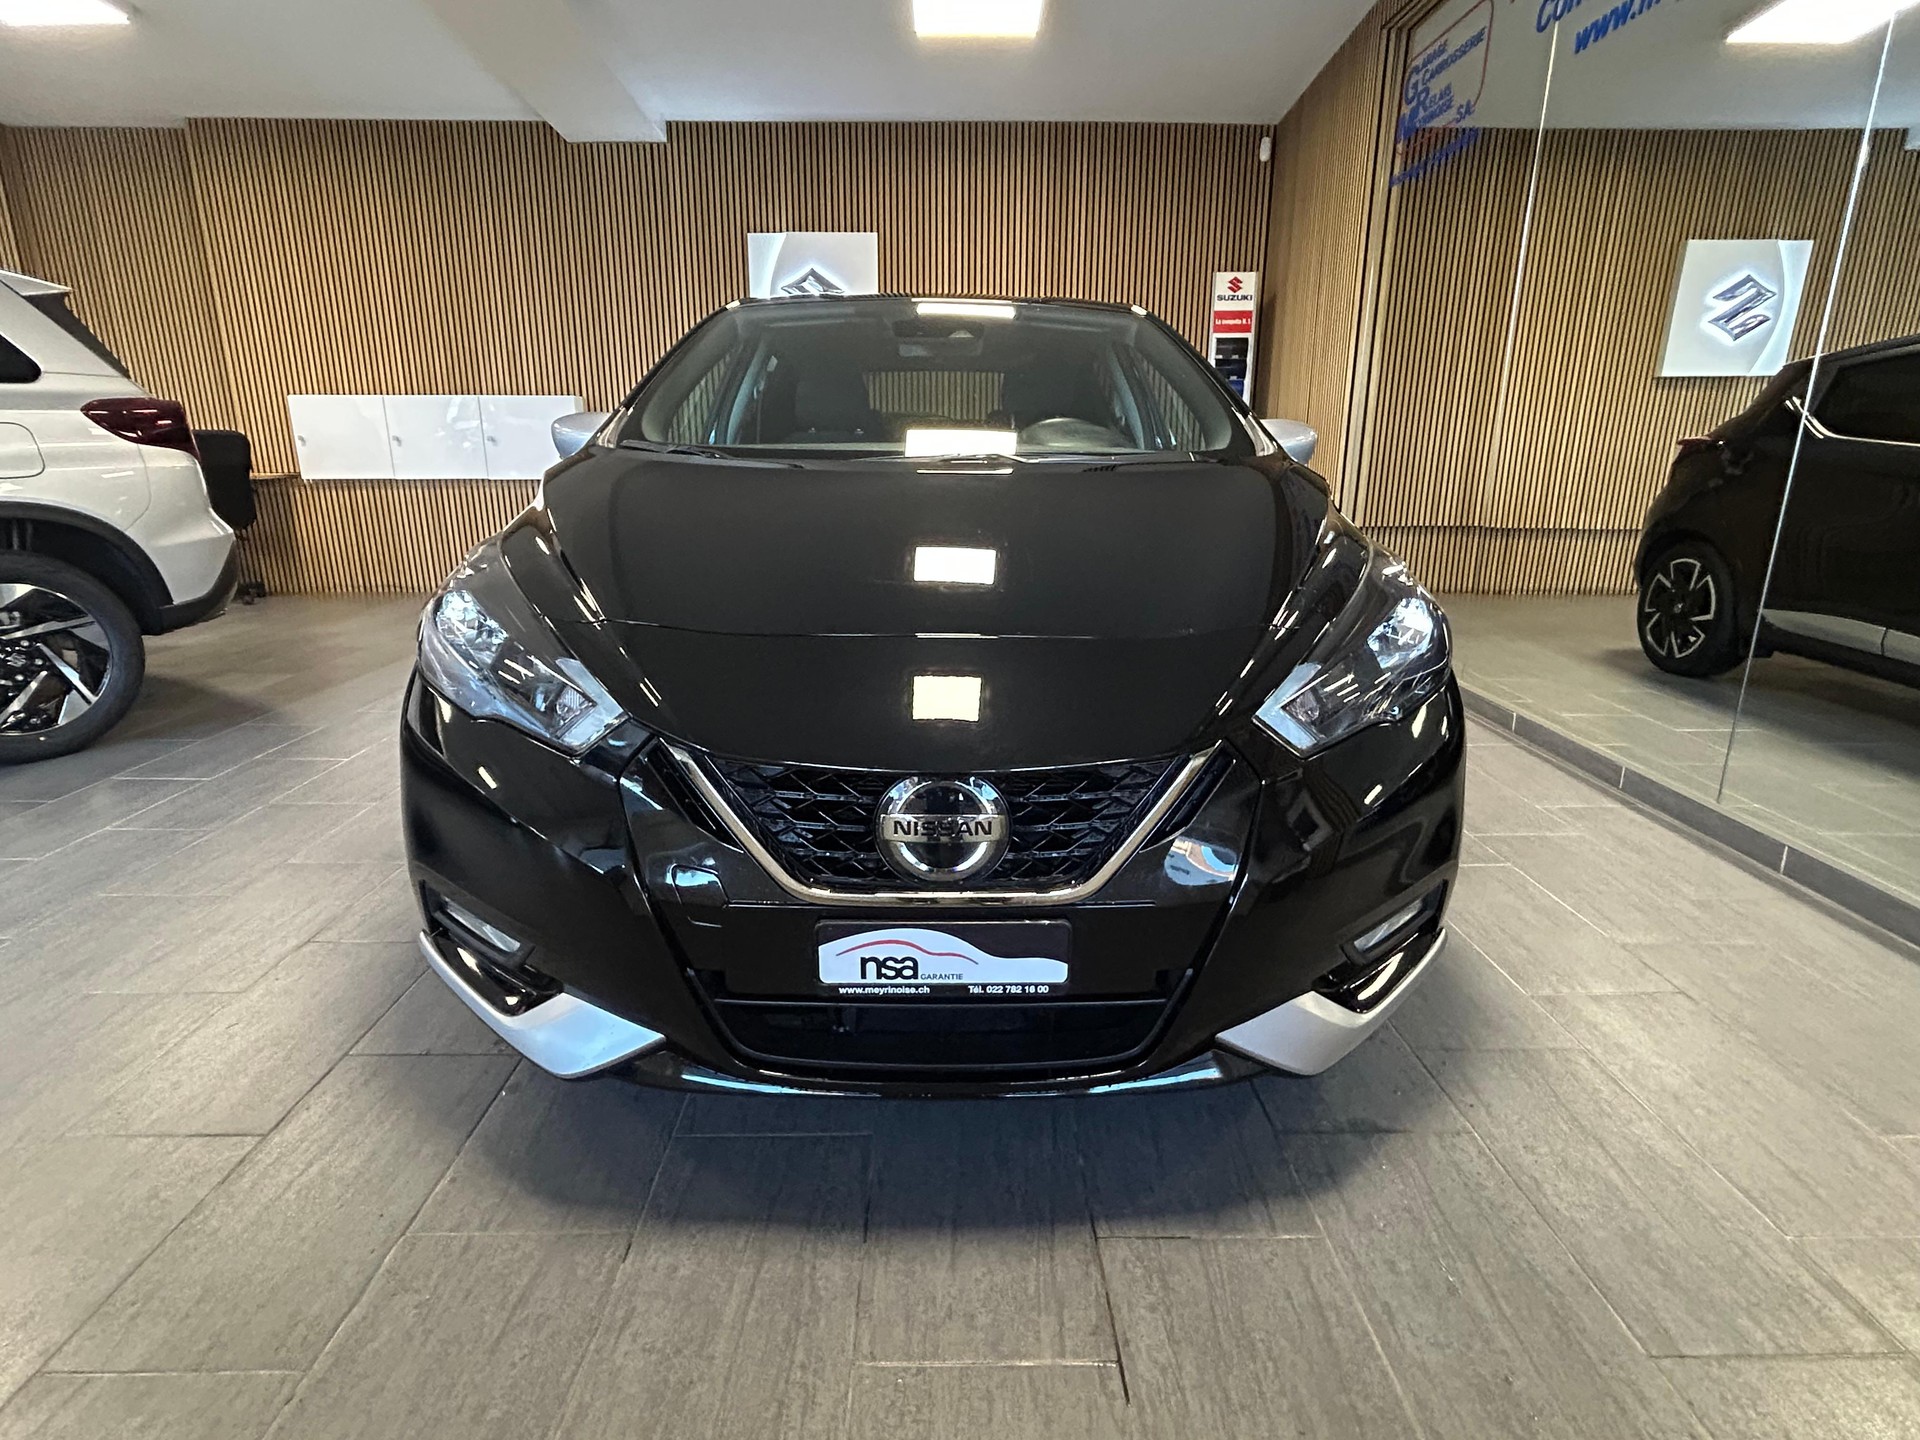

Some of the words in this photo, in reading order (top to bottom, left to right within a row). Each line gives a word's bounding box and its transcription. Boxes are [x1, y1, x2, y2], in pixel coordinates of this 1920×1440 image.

[893, 820, 993, 837] NISSAN
[860, 956, 919, 980] nsa
[838, 985, 931, 995] www.meyrinoise.ch
[986, 985, 1003, 994] 022
[1005, 985, 1022, 994] 782
[1038, 985, 1049, 994] 00
